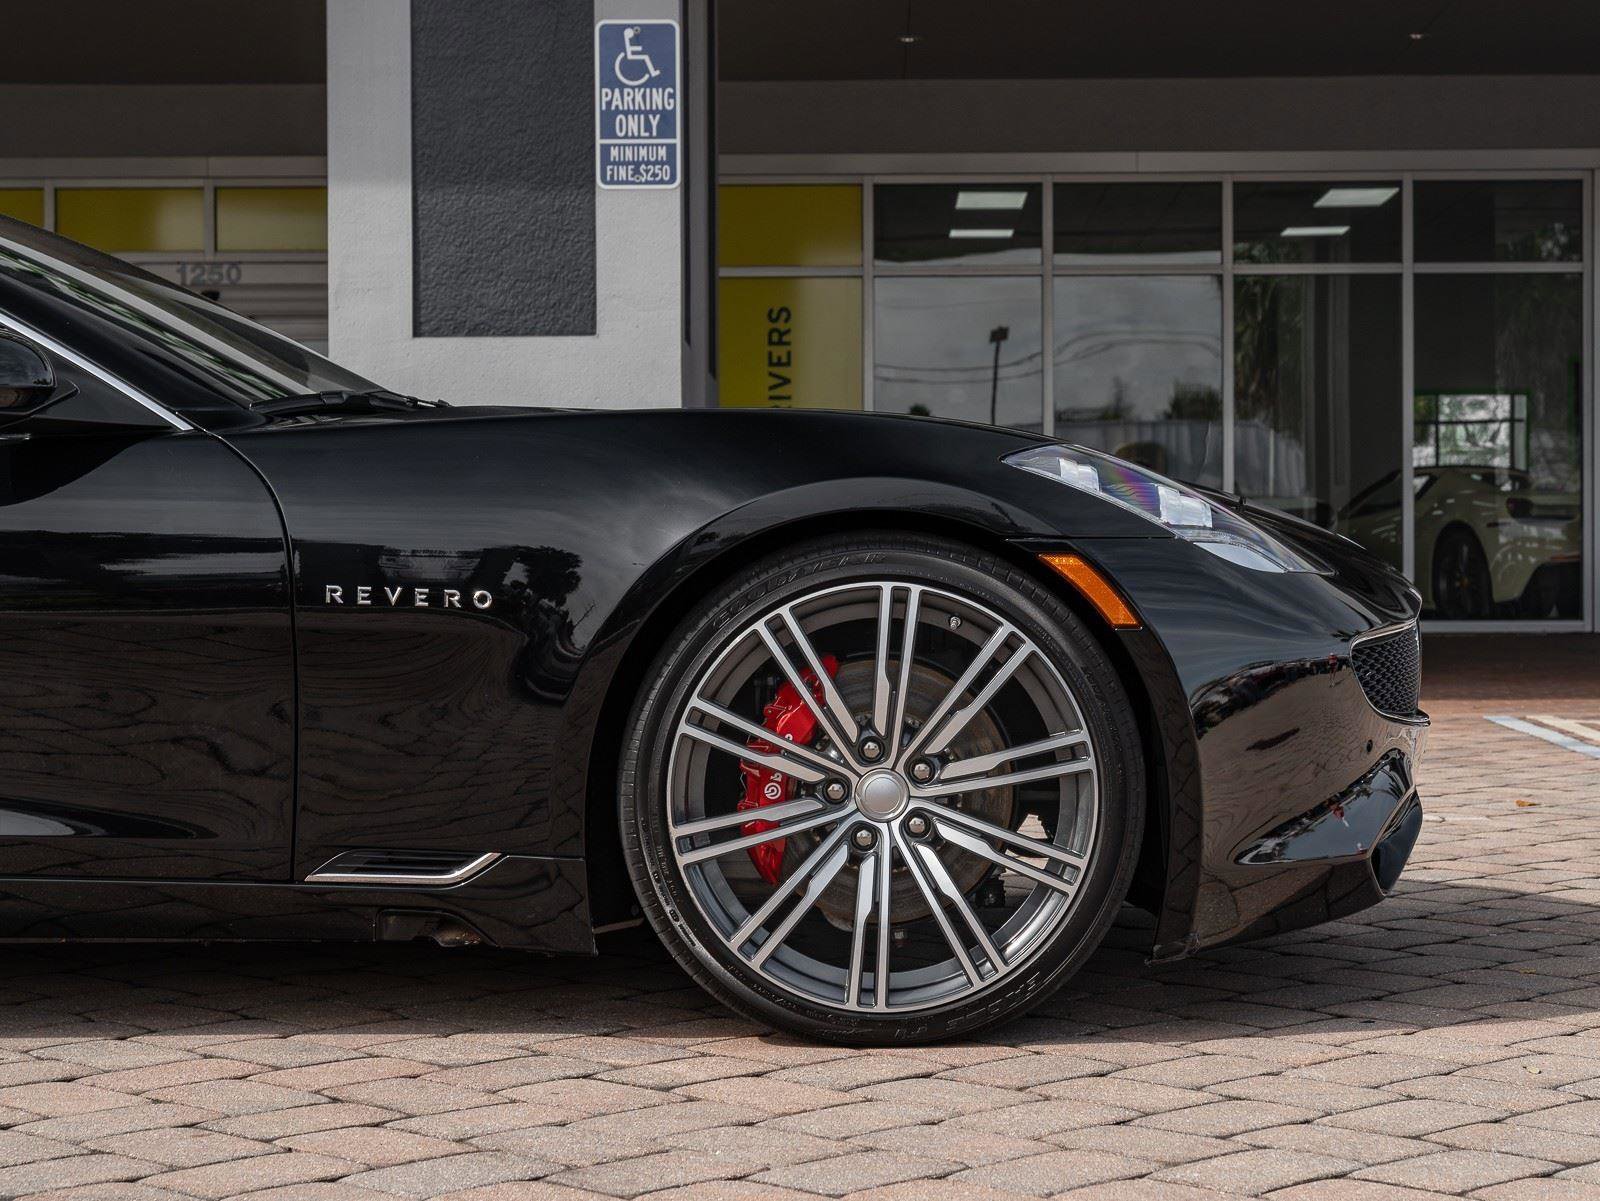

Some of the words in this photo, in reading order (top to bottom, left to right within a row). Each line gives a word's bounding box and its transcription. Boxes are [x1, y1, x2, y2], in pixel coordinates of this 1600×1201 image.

[601, 88, 675, 111] PARKING
[615, 114, 661, 138] ONLY
[610, 145, 667, 162] MINIMUM
[606, 164, 634, 182] FINE
[639, 164, 671, 183] $250
[176, 260, 242, 287] 1250
[766, 305, 793, 409] IVERS
[325, 584, 493, 610] REVERO
